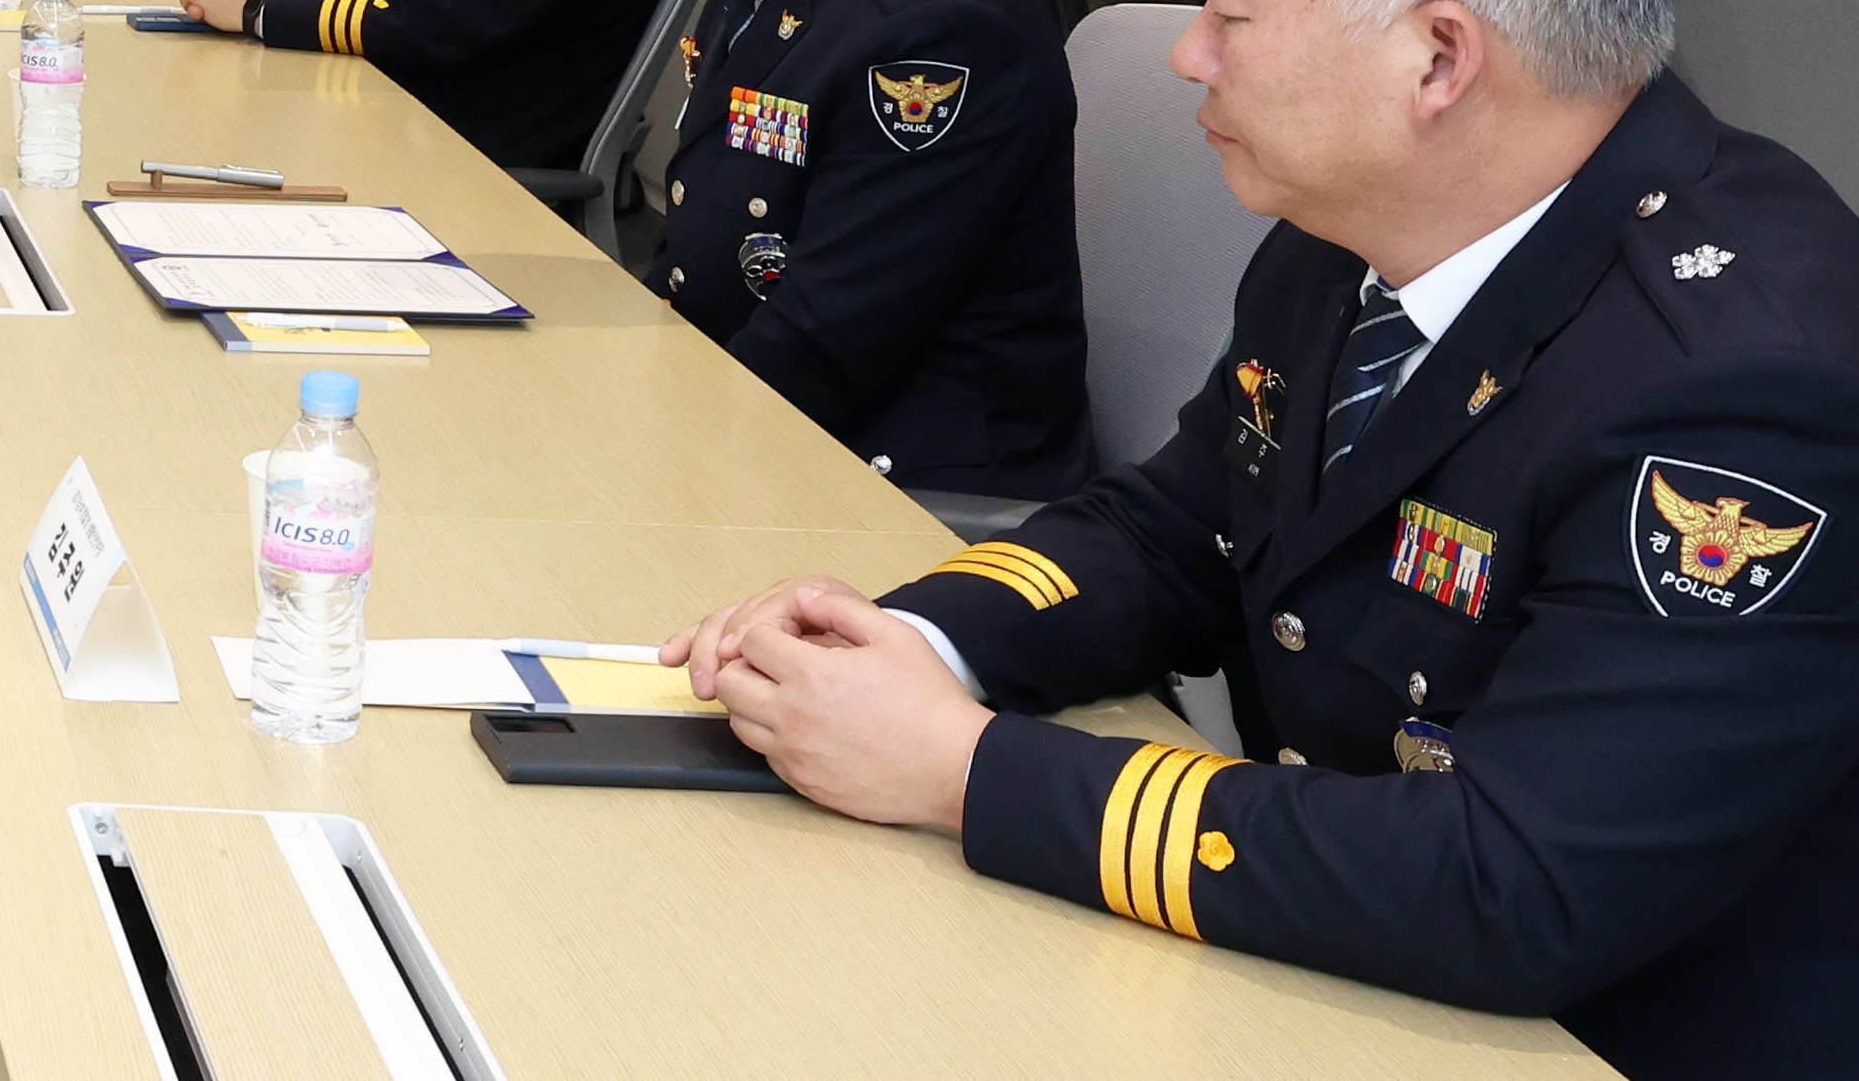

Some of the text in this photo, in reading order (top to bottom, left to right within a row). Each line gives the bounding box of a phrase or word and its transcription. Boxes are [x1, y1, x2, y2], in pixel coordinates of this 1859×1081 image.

[893, 121, 934, 134] POLICE
[1648, 531, 1772, 588] 경 찰
[1660, 570, 1736, 608] POLICE
